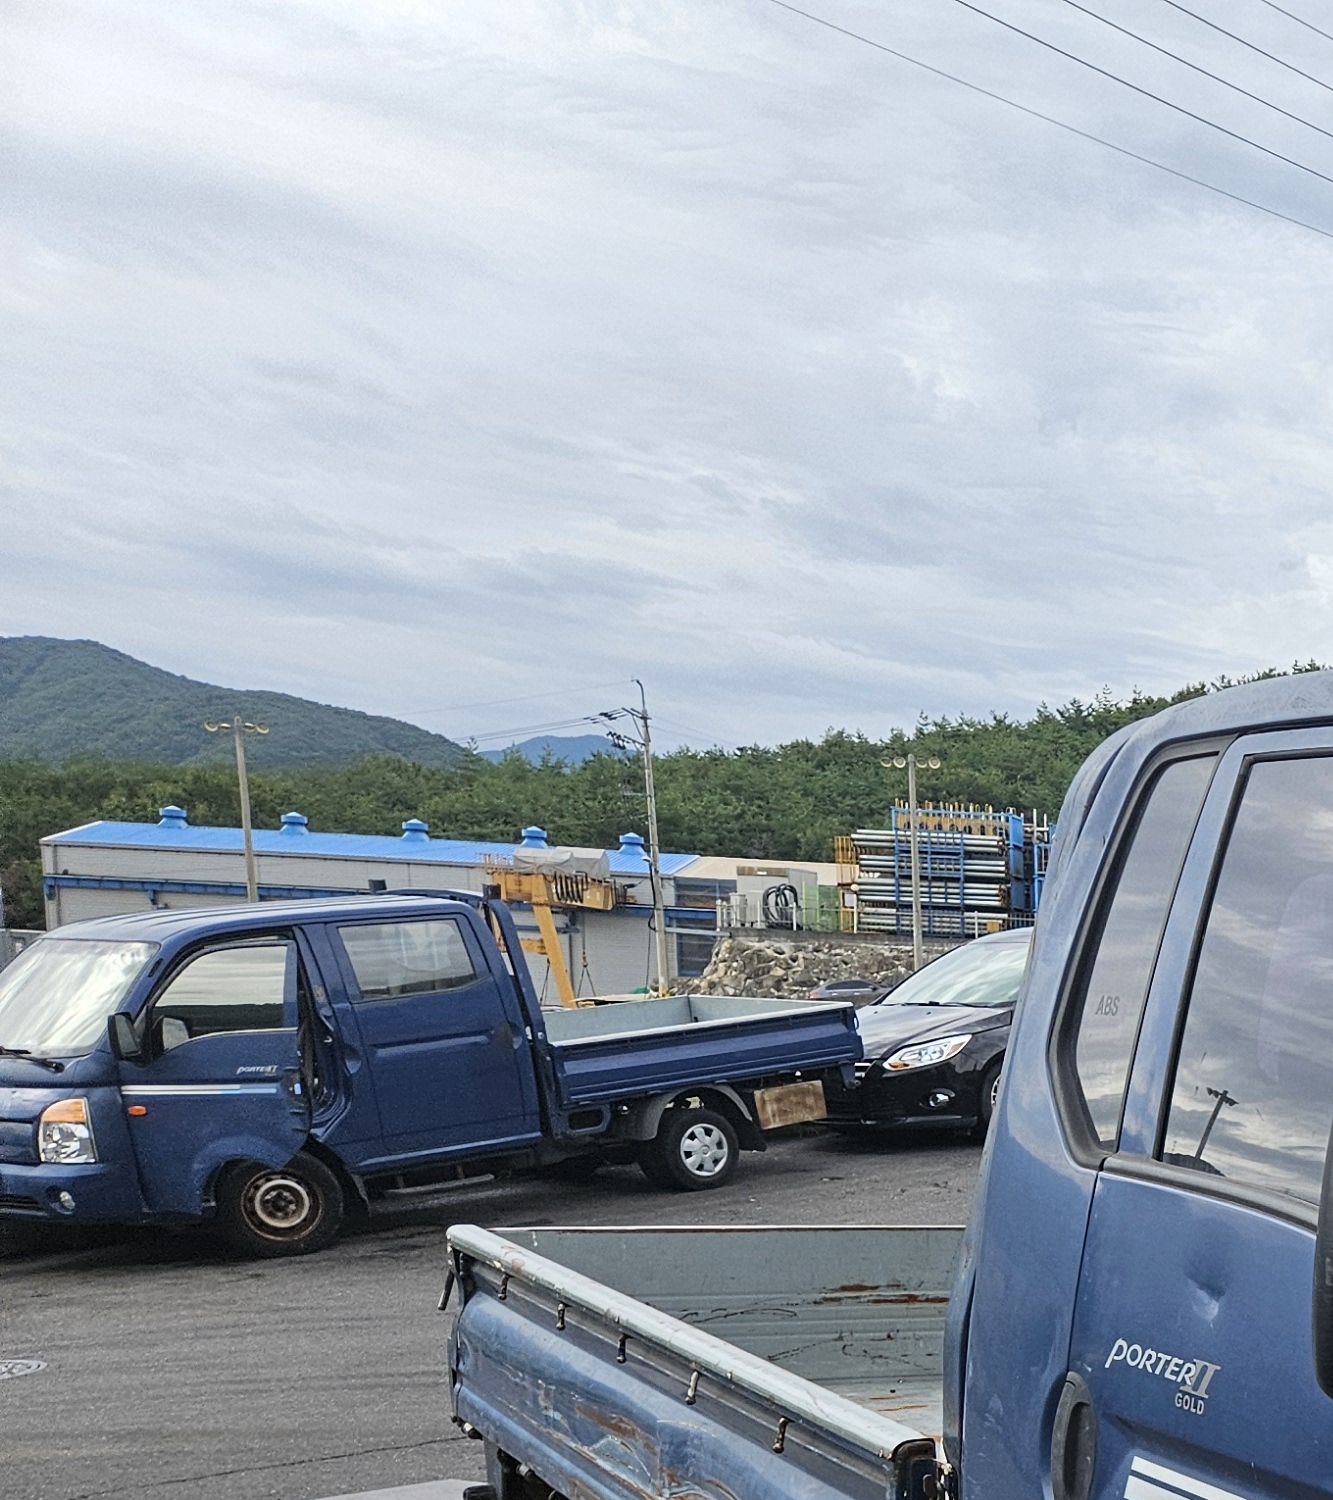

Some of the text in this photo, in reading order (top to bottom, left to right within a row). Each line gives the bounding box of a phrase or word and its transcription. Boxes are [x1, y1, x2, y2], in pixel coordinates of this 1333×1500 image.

[1095, 995, 1120, 1016] ABS
[1104, 1337, 1197, 1386] PORTER
[1174, 1392, 1205, 1416] GOLD
